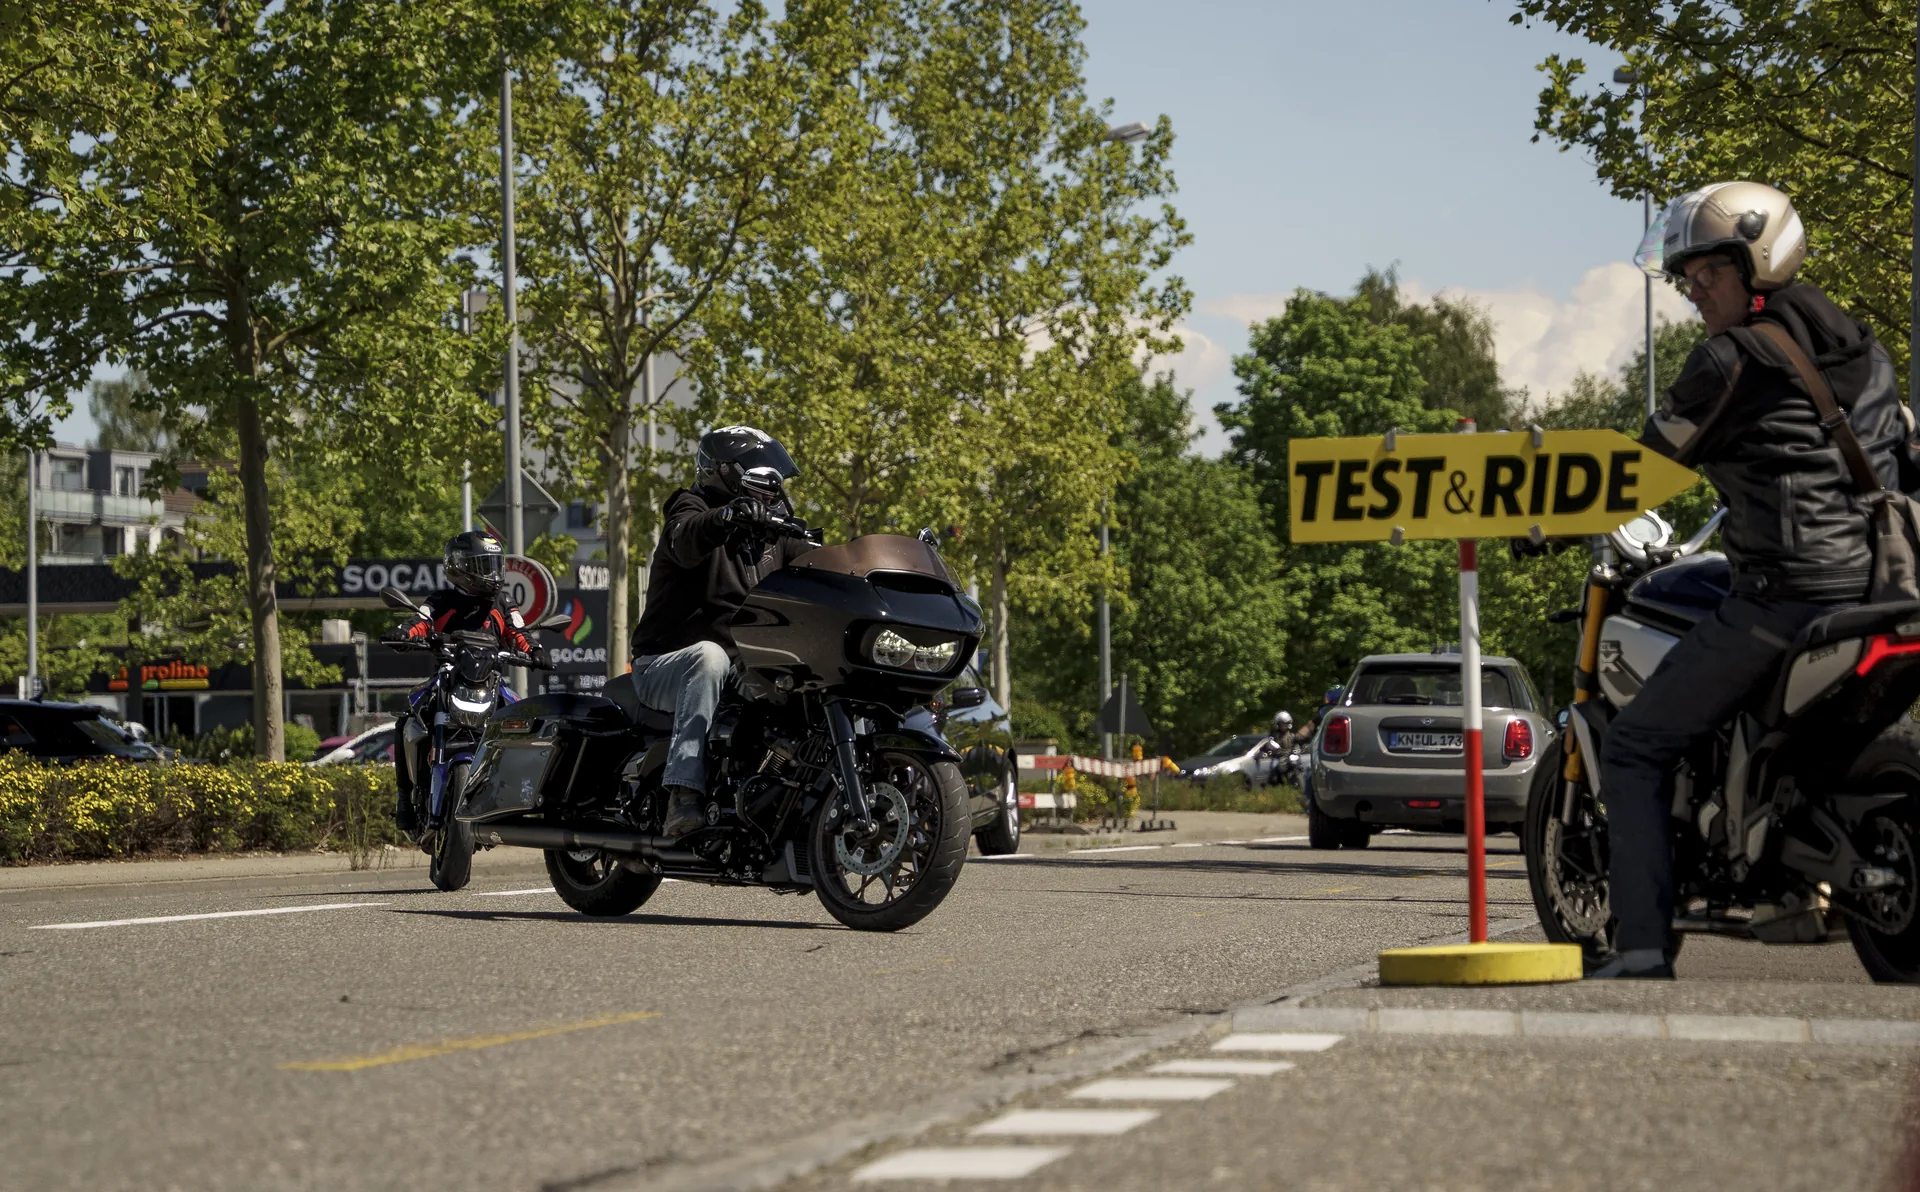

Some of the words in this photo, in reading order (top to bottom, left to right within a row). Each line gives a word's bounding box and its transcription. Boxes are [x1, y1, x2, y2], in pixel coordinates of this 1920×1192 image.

[550, 648, 606, 662] SOCAR
[1397, 734, 1414, 746] KN
[1421, 734, 1437, 746] UL
